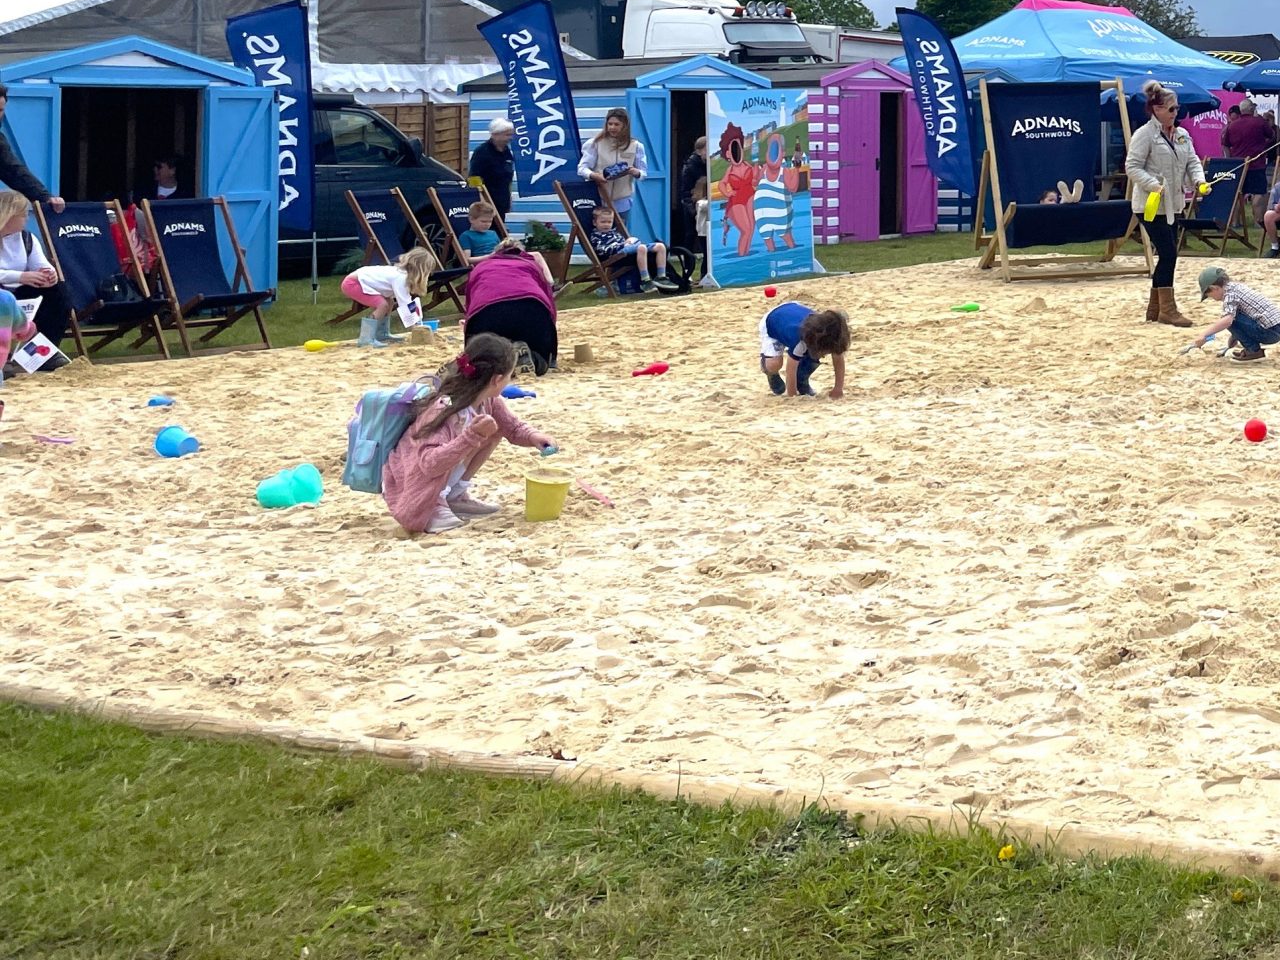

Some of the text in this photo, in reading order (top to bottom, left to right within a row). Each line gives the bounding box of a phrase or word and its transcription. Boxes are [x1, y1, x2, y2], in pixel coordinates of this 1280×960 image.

[964, 36, 1026, 48] ADNAMS
[741, 96, 777, 113] ADNAMS
[1025, 131, 1072, 139] SOUTHWOLD
